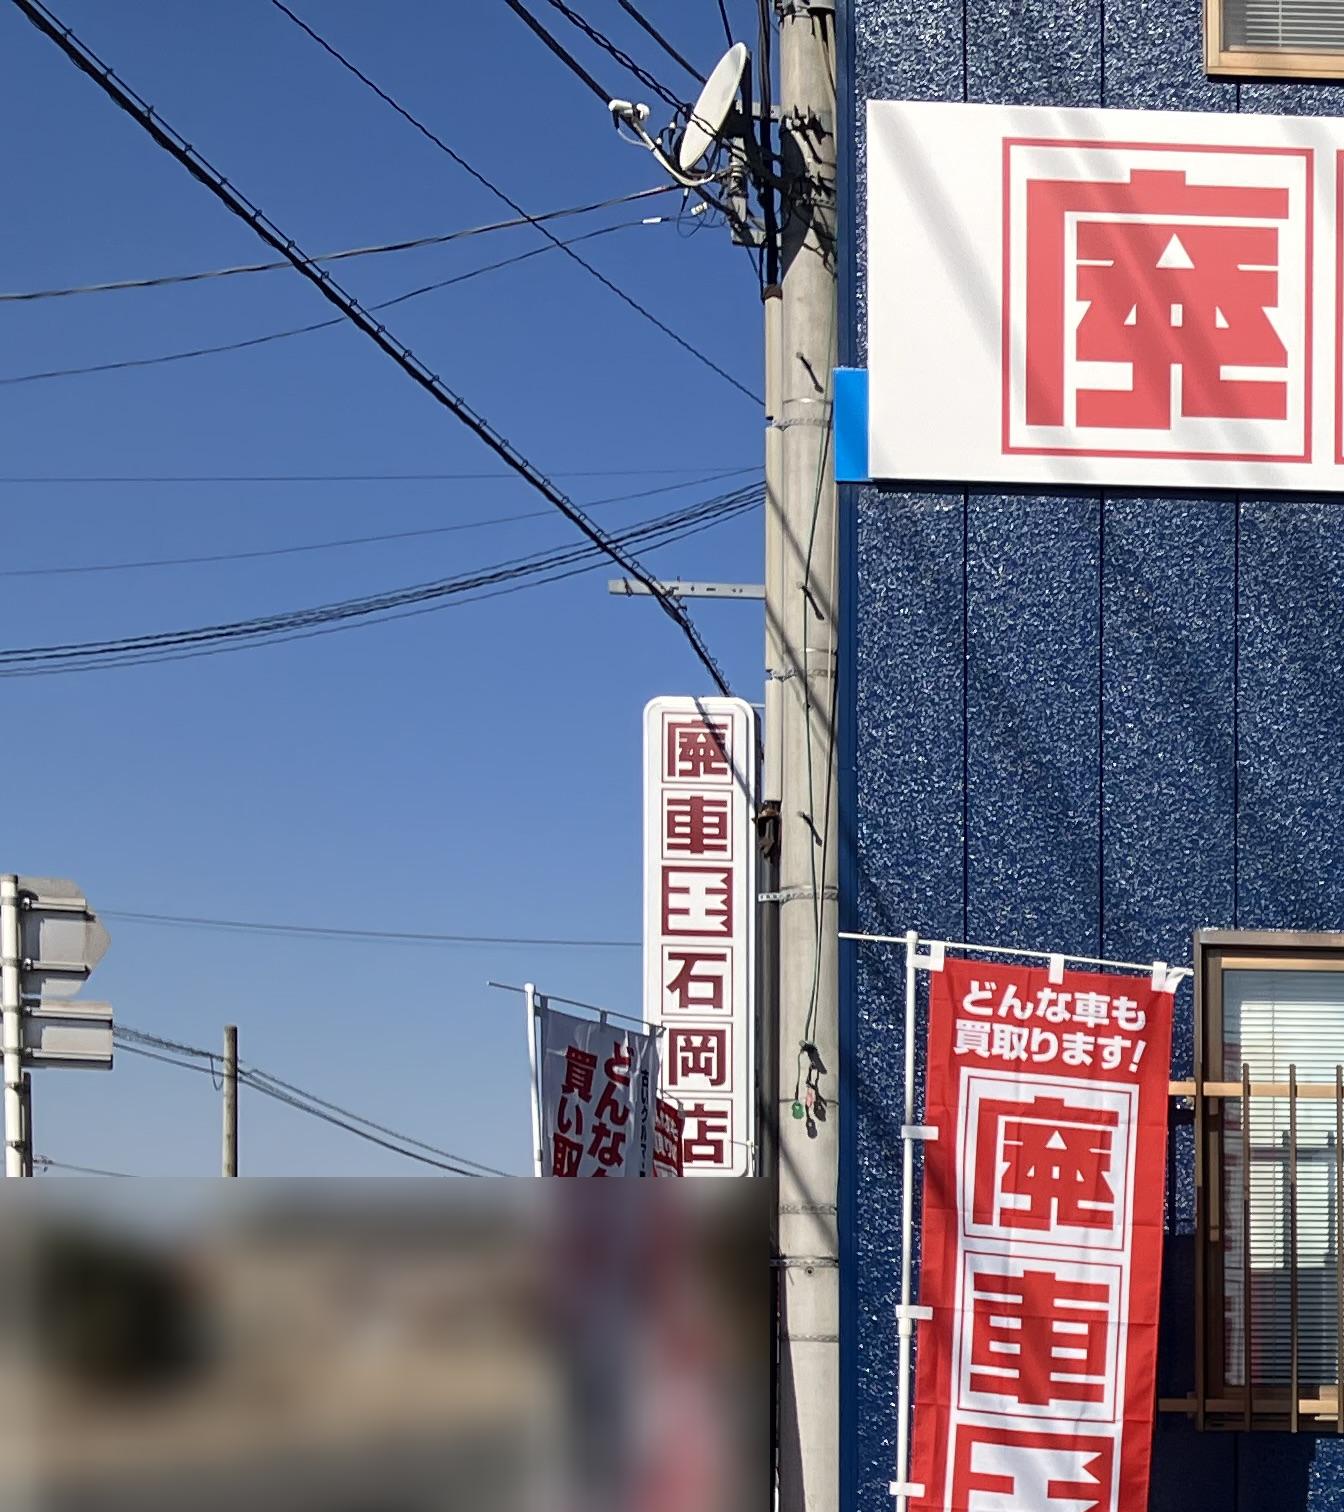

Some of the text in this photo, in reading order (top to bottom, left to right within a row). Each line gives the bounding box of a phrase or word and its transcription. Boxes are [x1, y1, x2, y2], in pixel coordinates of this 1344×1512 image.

[663, 718, 734, 1166] 廃車王石岡店
[962, 980, 1146, 1031] どんな車も
[588, 1040, 634, 1177] どんな
